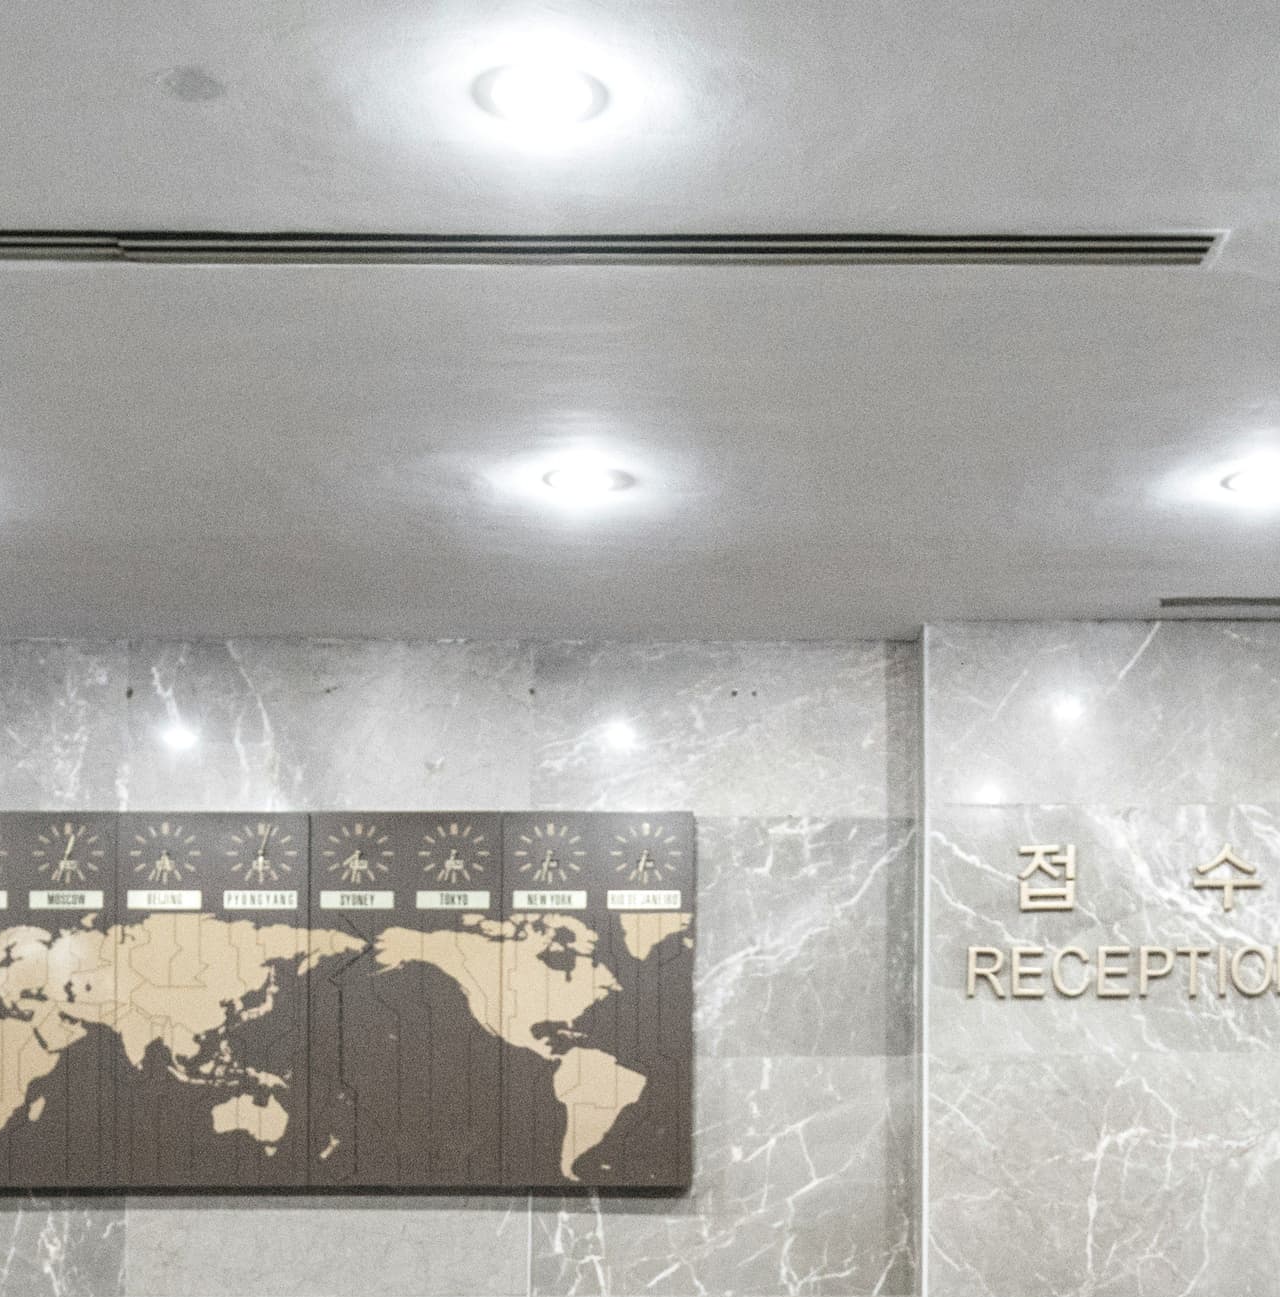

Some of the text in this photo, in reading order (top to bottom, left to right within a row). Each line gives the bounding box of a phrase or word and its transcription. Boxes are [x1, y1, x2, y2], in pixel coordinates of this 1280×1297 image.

[47, 892, 85, 905] MOSCOW
[146, 893, 183, 905] BEIJING
[226, 893, 295, 906] PYONGYANG
[339, 893, 375, 906] SYDNEY
[439, 892, 469, 906] TOKYO
[527, 893, 572, 906] NEW YORK
[610, 893, 679, 905] RIO DE JANEIRO
